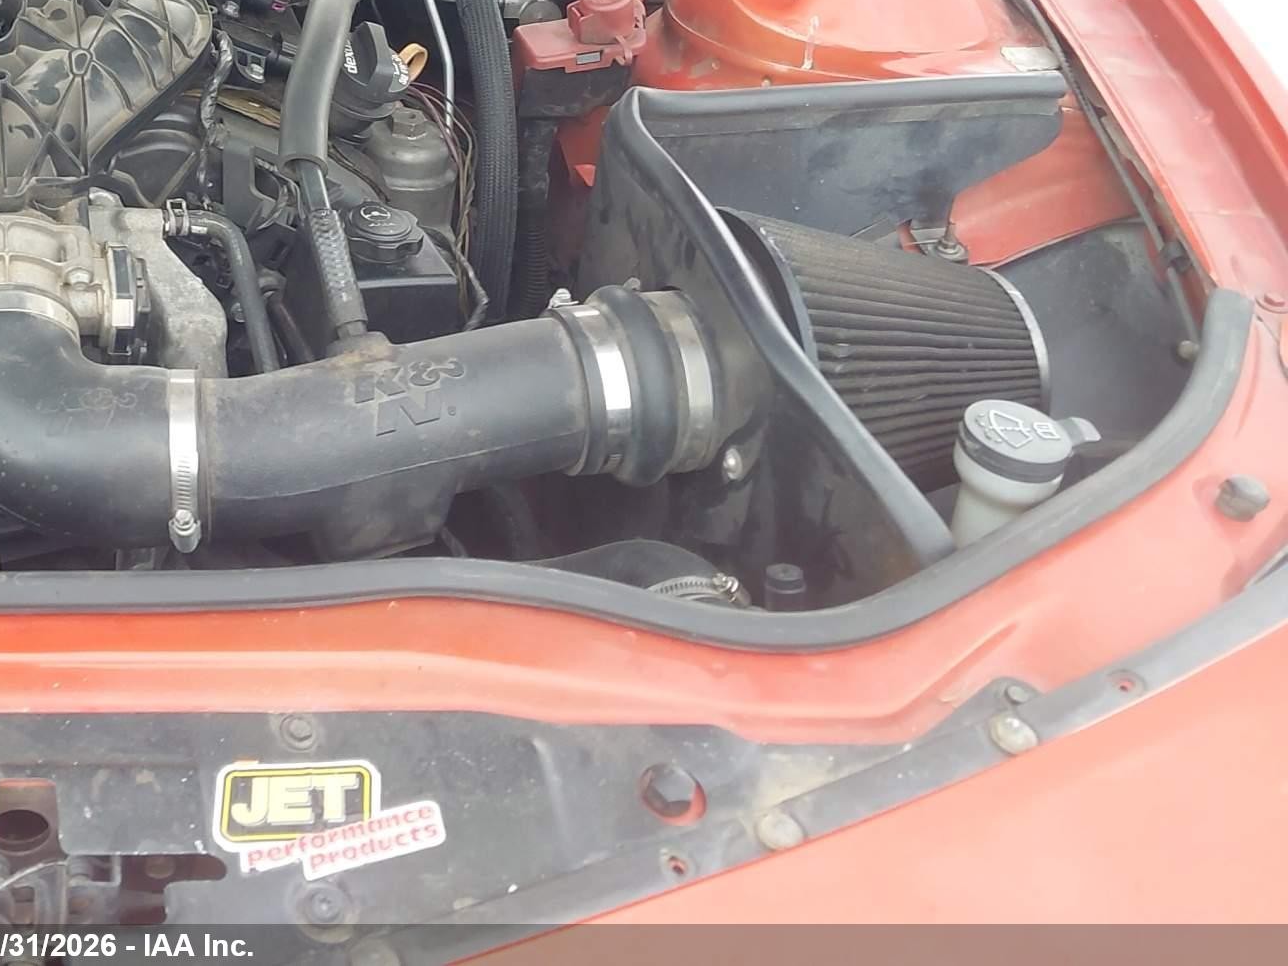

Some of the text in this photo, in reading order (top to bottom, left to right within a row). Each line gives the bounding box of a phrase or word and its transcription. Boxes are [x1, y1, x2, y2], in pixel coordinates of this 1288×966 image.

[343, 38, 359, 75] dex
[230, 773, 360, 826] JET
[247, 805, 434, 869] performance
[309, 823, 439, 872] products
